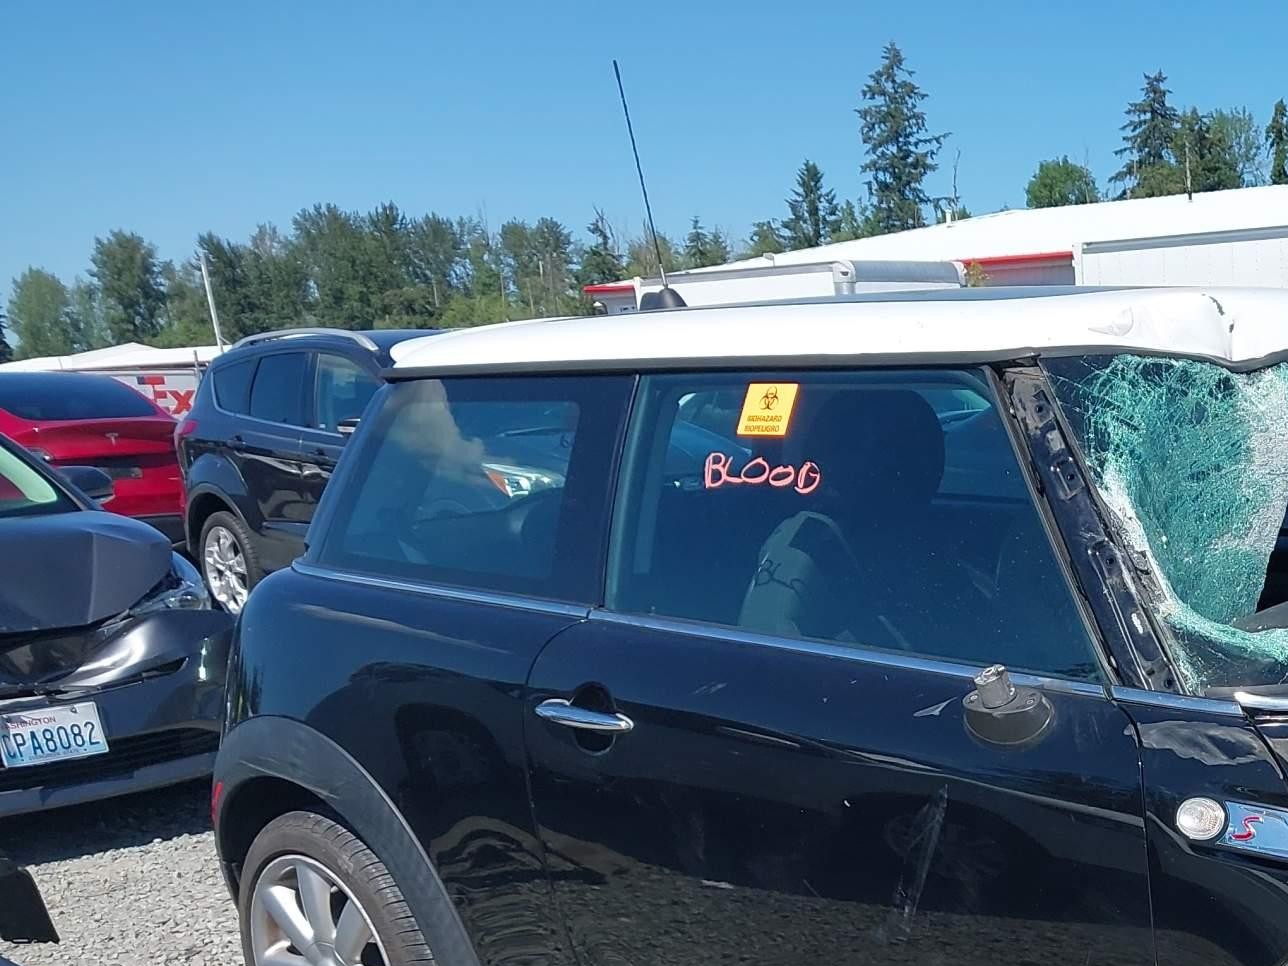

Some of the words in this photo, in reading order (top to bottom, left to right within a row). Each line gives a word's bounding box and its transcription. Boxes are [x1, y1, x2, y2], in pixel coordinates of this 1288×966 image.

[137, 376, 195, 415] Ex
[704, 452, 821, 494] BLOOD
[2, 716, 57, 731] ASHINGTON
[2, 721, 100, 759] CPA8082
[1231, 816, 1264, 842] S
